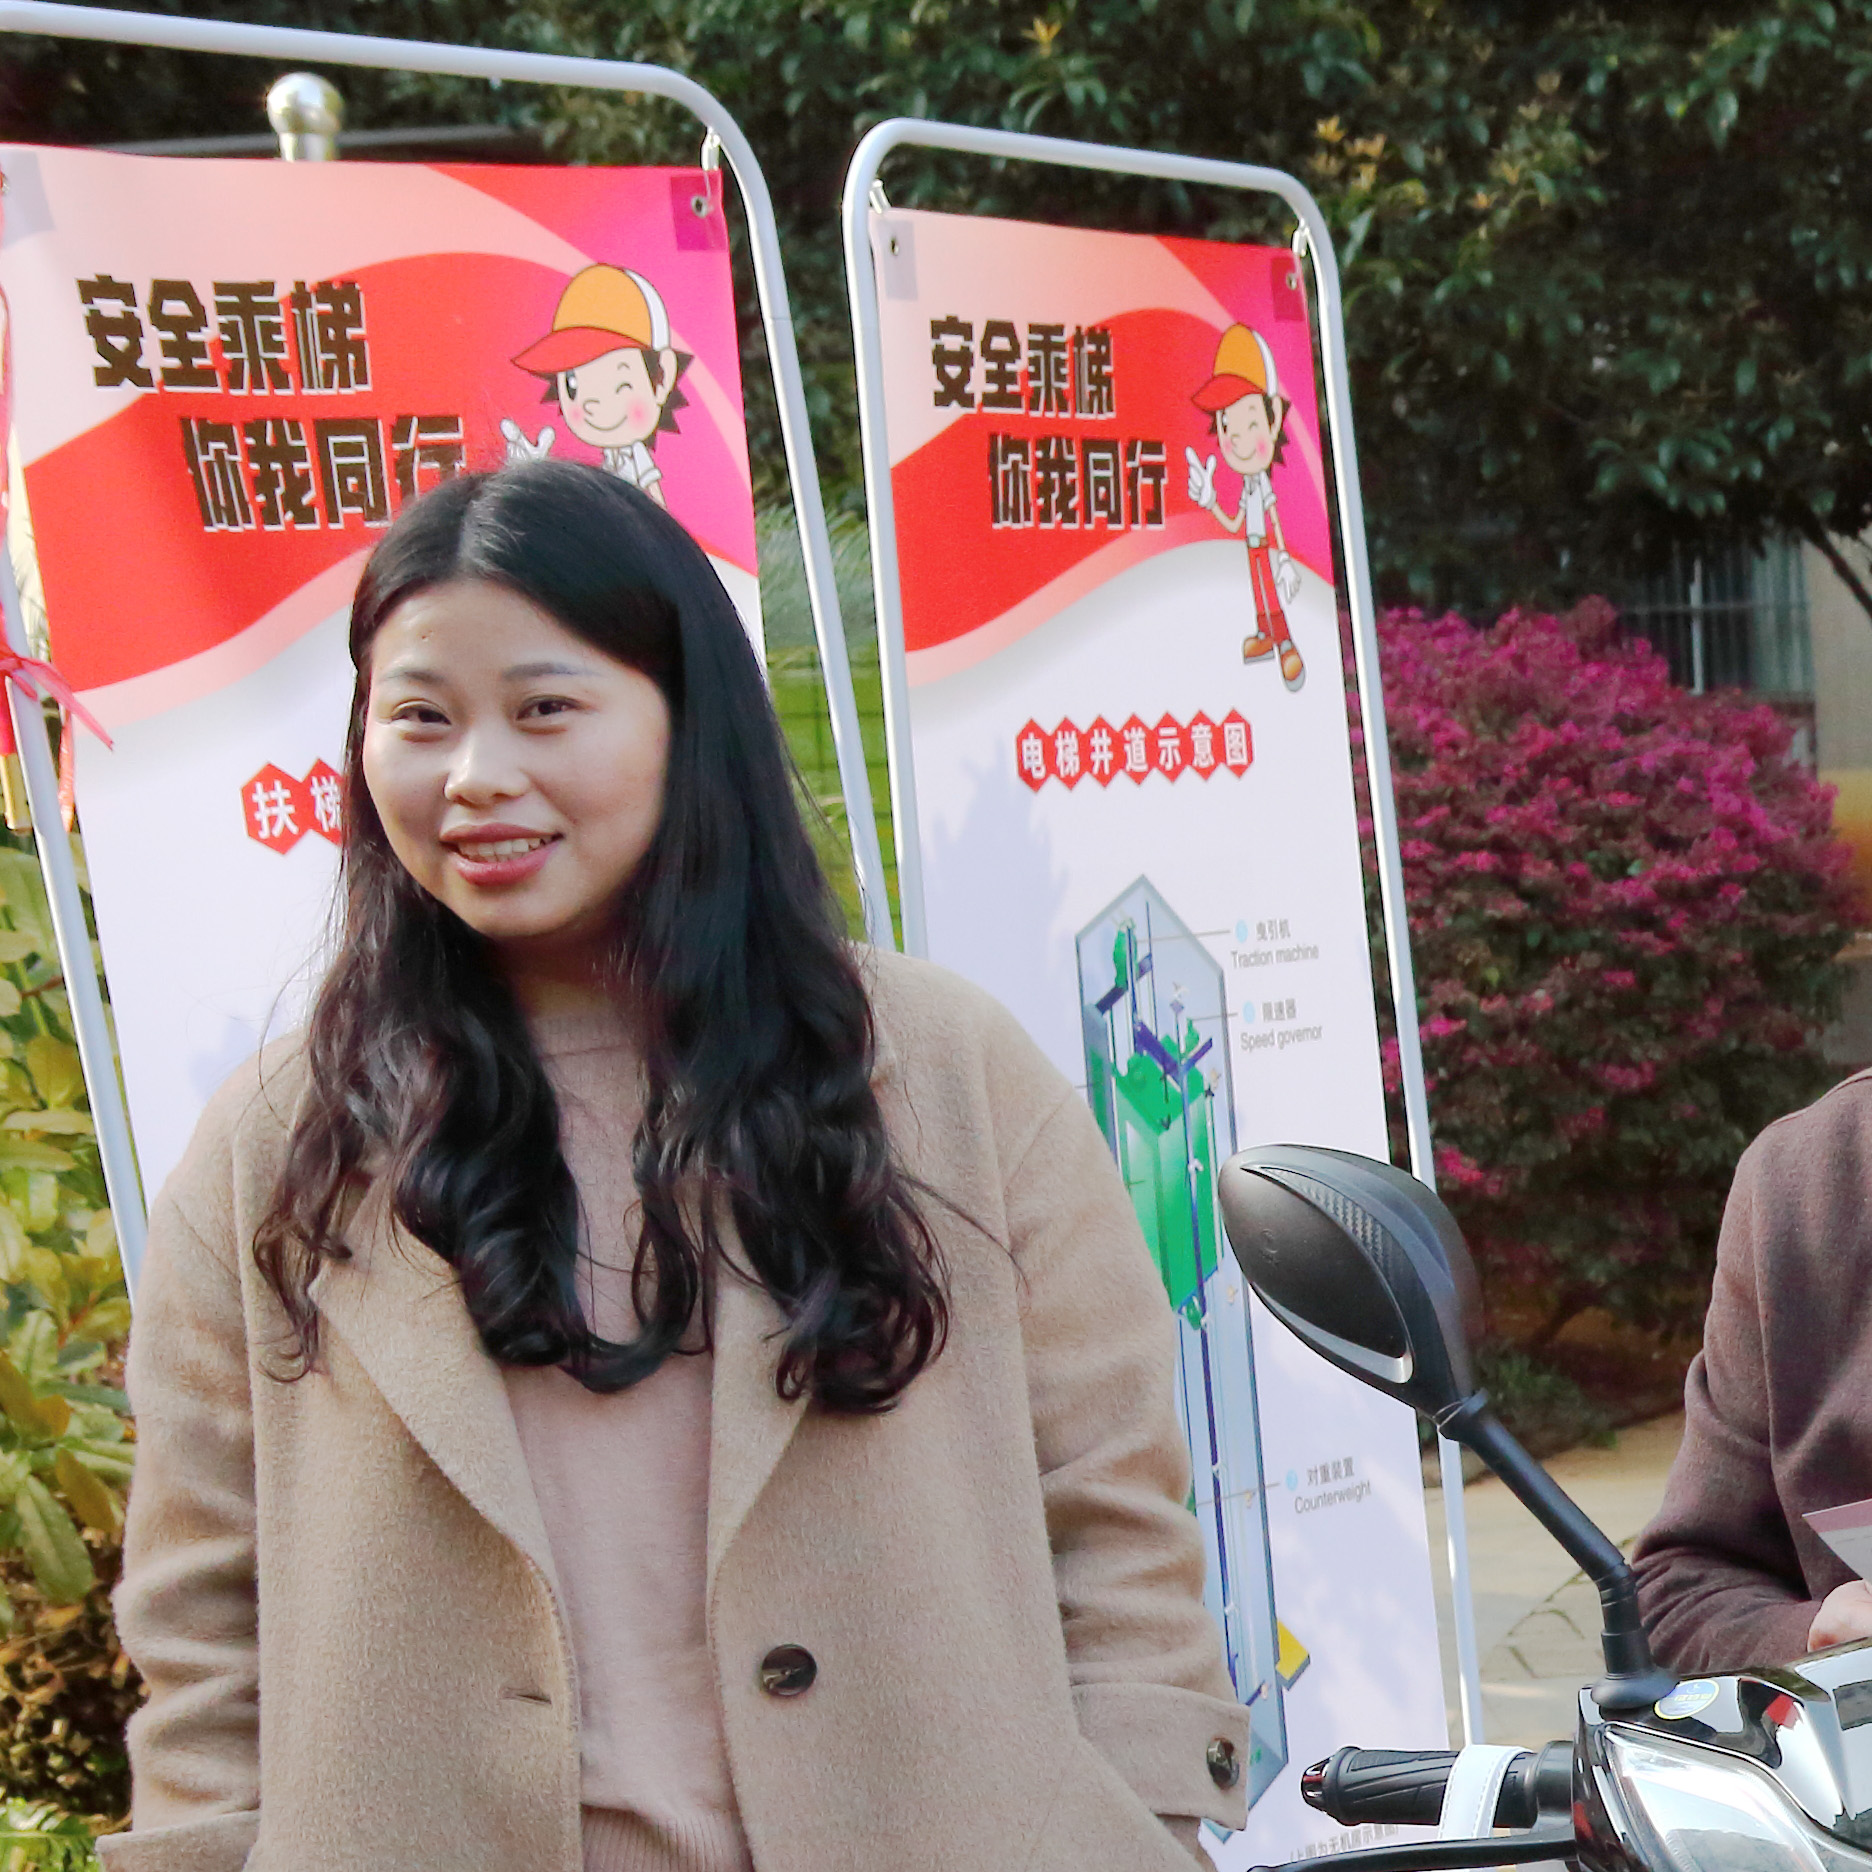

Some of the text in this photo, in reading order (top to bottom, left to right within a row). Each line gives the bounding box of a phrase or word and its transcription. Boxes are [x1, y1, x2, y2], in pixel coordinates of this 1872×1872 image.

[76, 273, 372, 394] 安全乘梯
[929, 315, 1116, 420] 安全乘梯
[987, 433, 1168, 531] 你我同行
[1020, 719, 1252, 781] 电梯井道示意图
[1230, 943, 1319, 969] Traction machine
[1240, 1024, 1323, 1053] Speed governor
[1294, 1480, 1372, 1515] Counterweight
